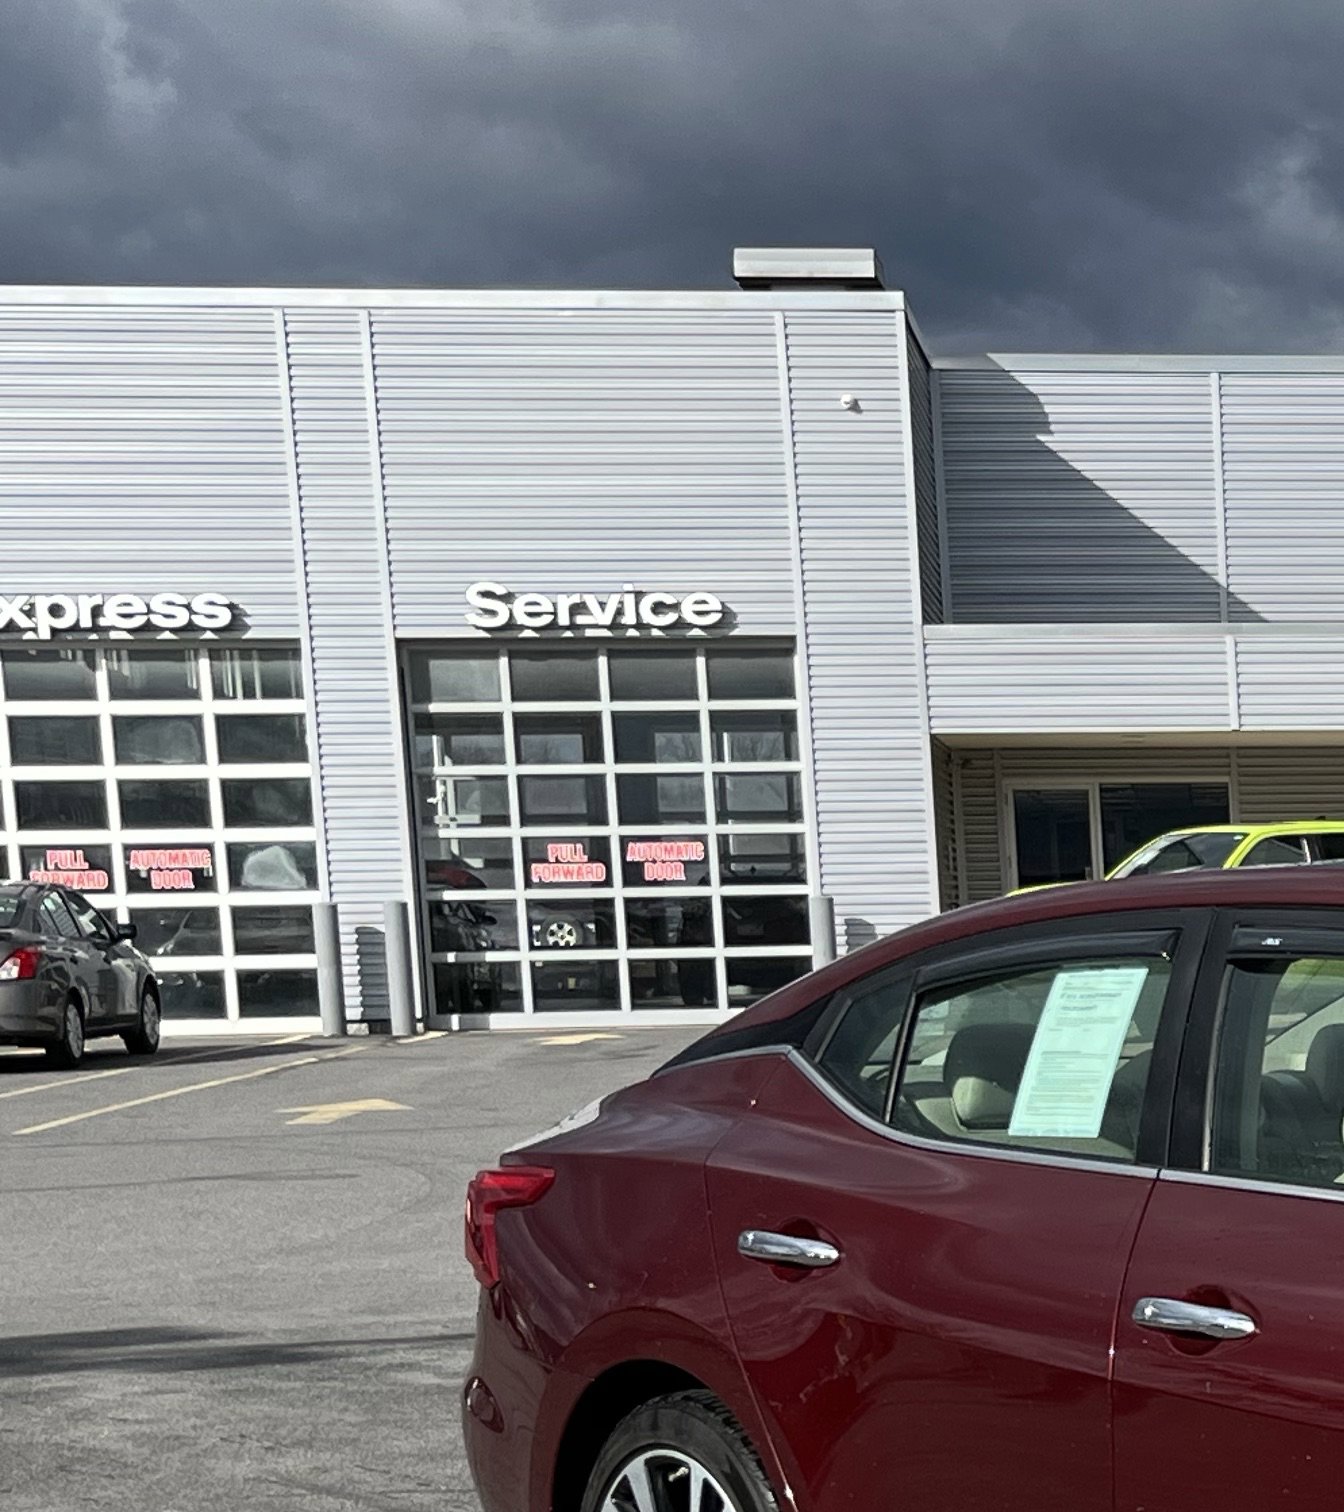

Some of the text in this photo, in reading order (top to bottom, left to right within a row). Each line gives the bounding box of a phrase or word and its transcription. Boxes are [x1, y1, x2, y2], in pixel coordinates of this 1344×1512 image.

[464, 581, 724, 628] Service
[46, 850, 89, 870] PULL
[130, 849, 212, 870] AUTOMATIC
[548, 843, 588, 862] PULL
[627, 842, 705, 861] AUTOMATIC
[30, 870, 109, 889] FORWARD
[151, 870, 195, 889] DOOR
[531, 863, 606, 882] FORWARD
[644, 861, 686, 881] DOOR
